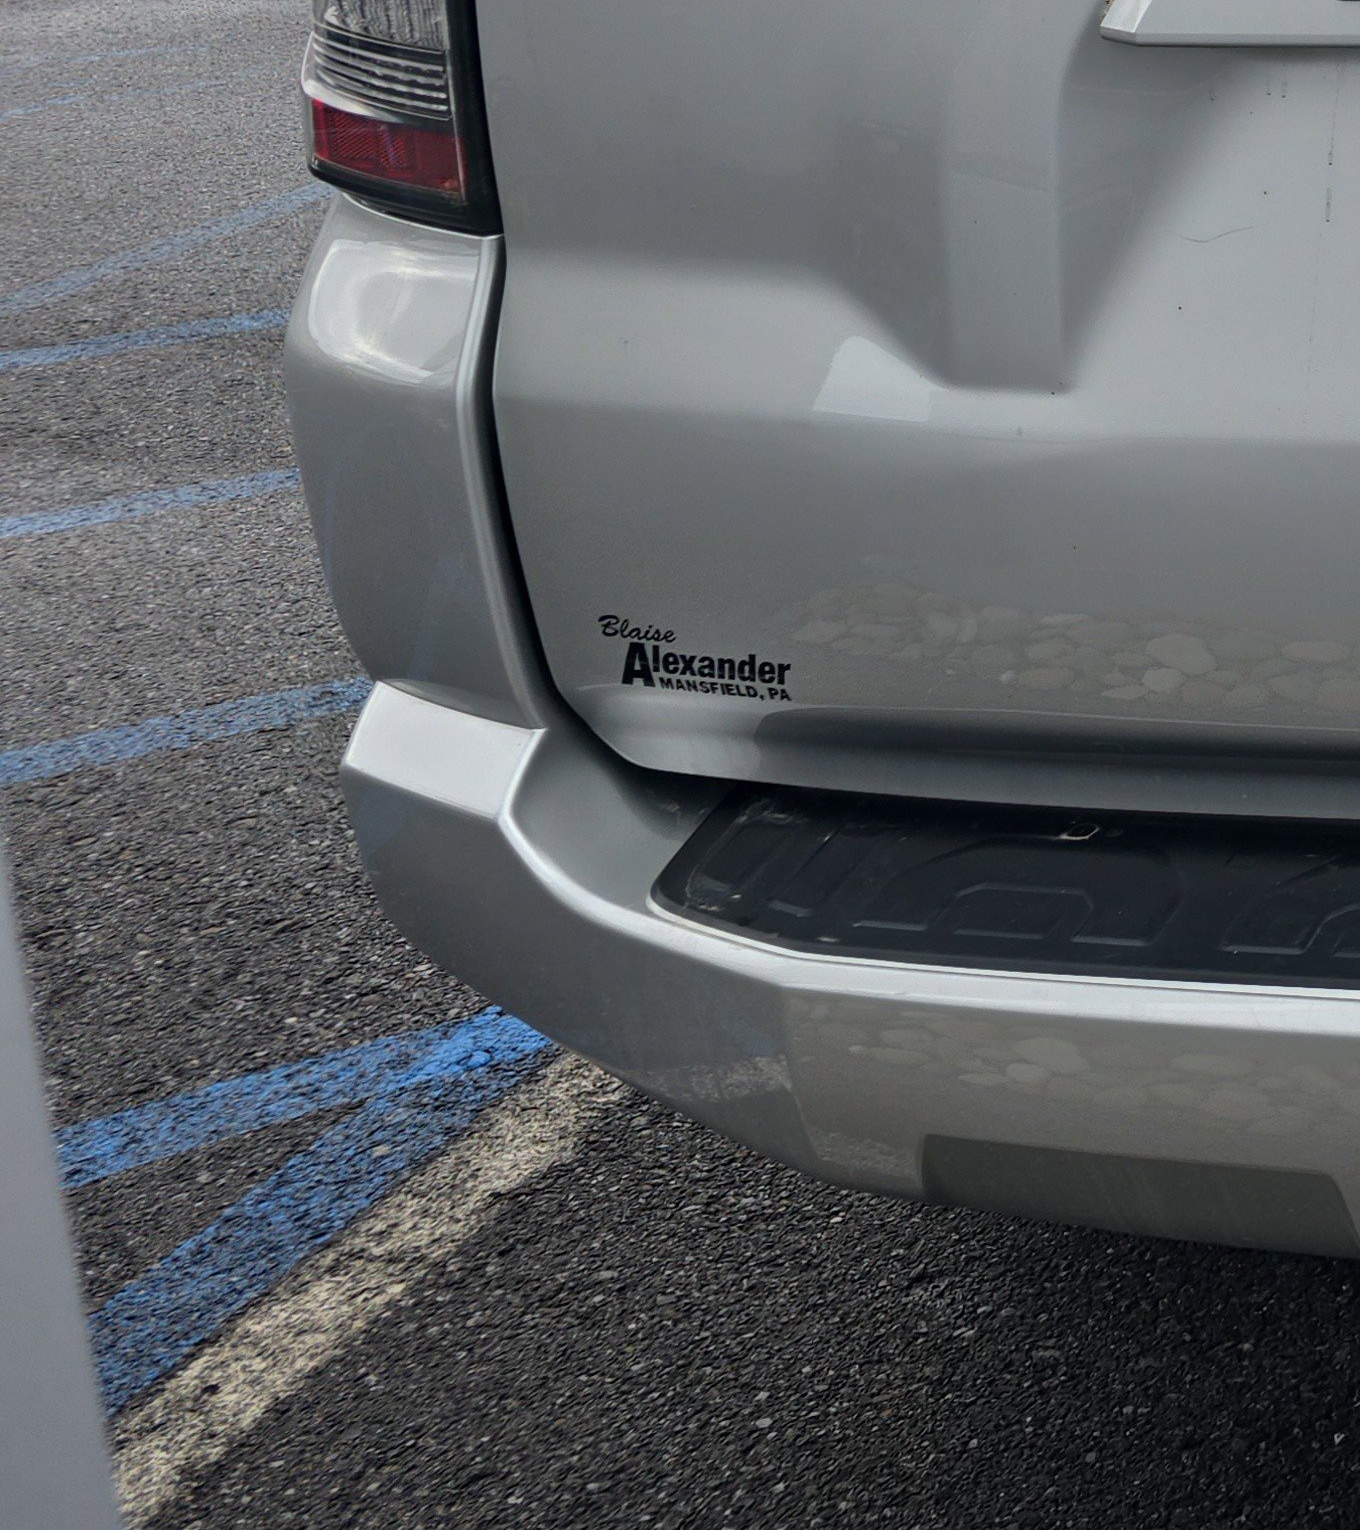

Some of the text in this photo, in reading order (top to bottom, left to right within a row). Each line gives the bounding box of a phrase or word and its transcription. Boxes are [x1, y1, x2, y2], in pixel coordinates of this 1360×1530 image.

[598, 615, 676, 643] Blaise
[621, 642, 791, 688] Alexander
[659, 677, 792, 701] MANSFIELD, PA
